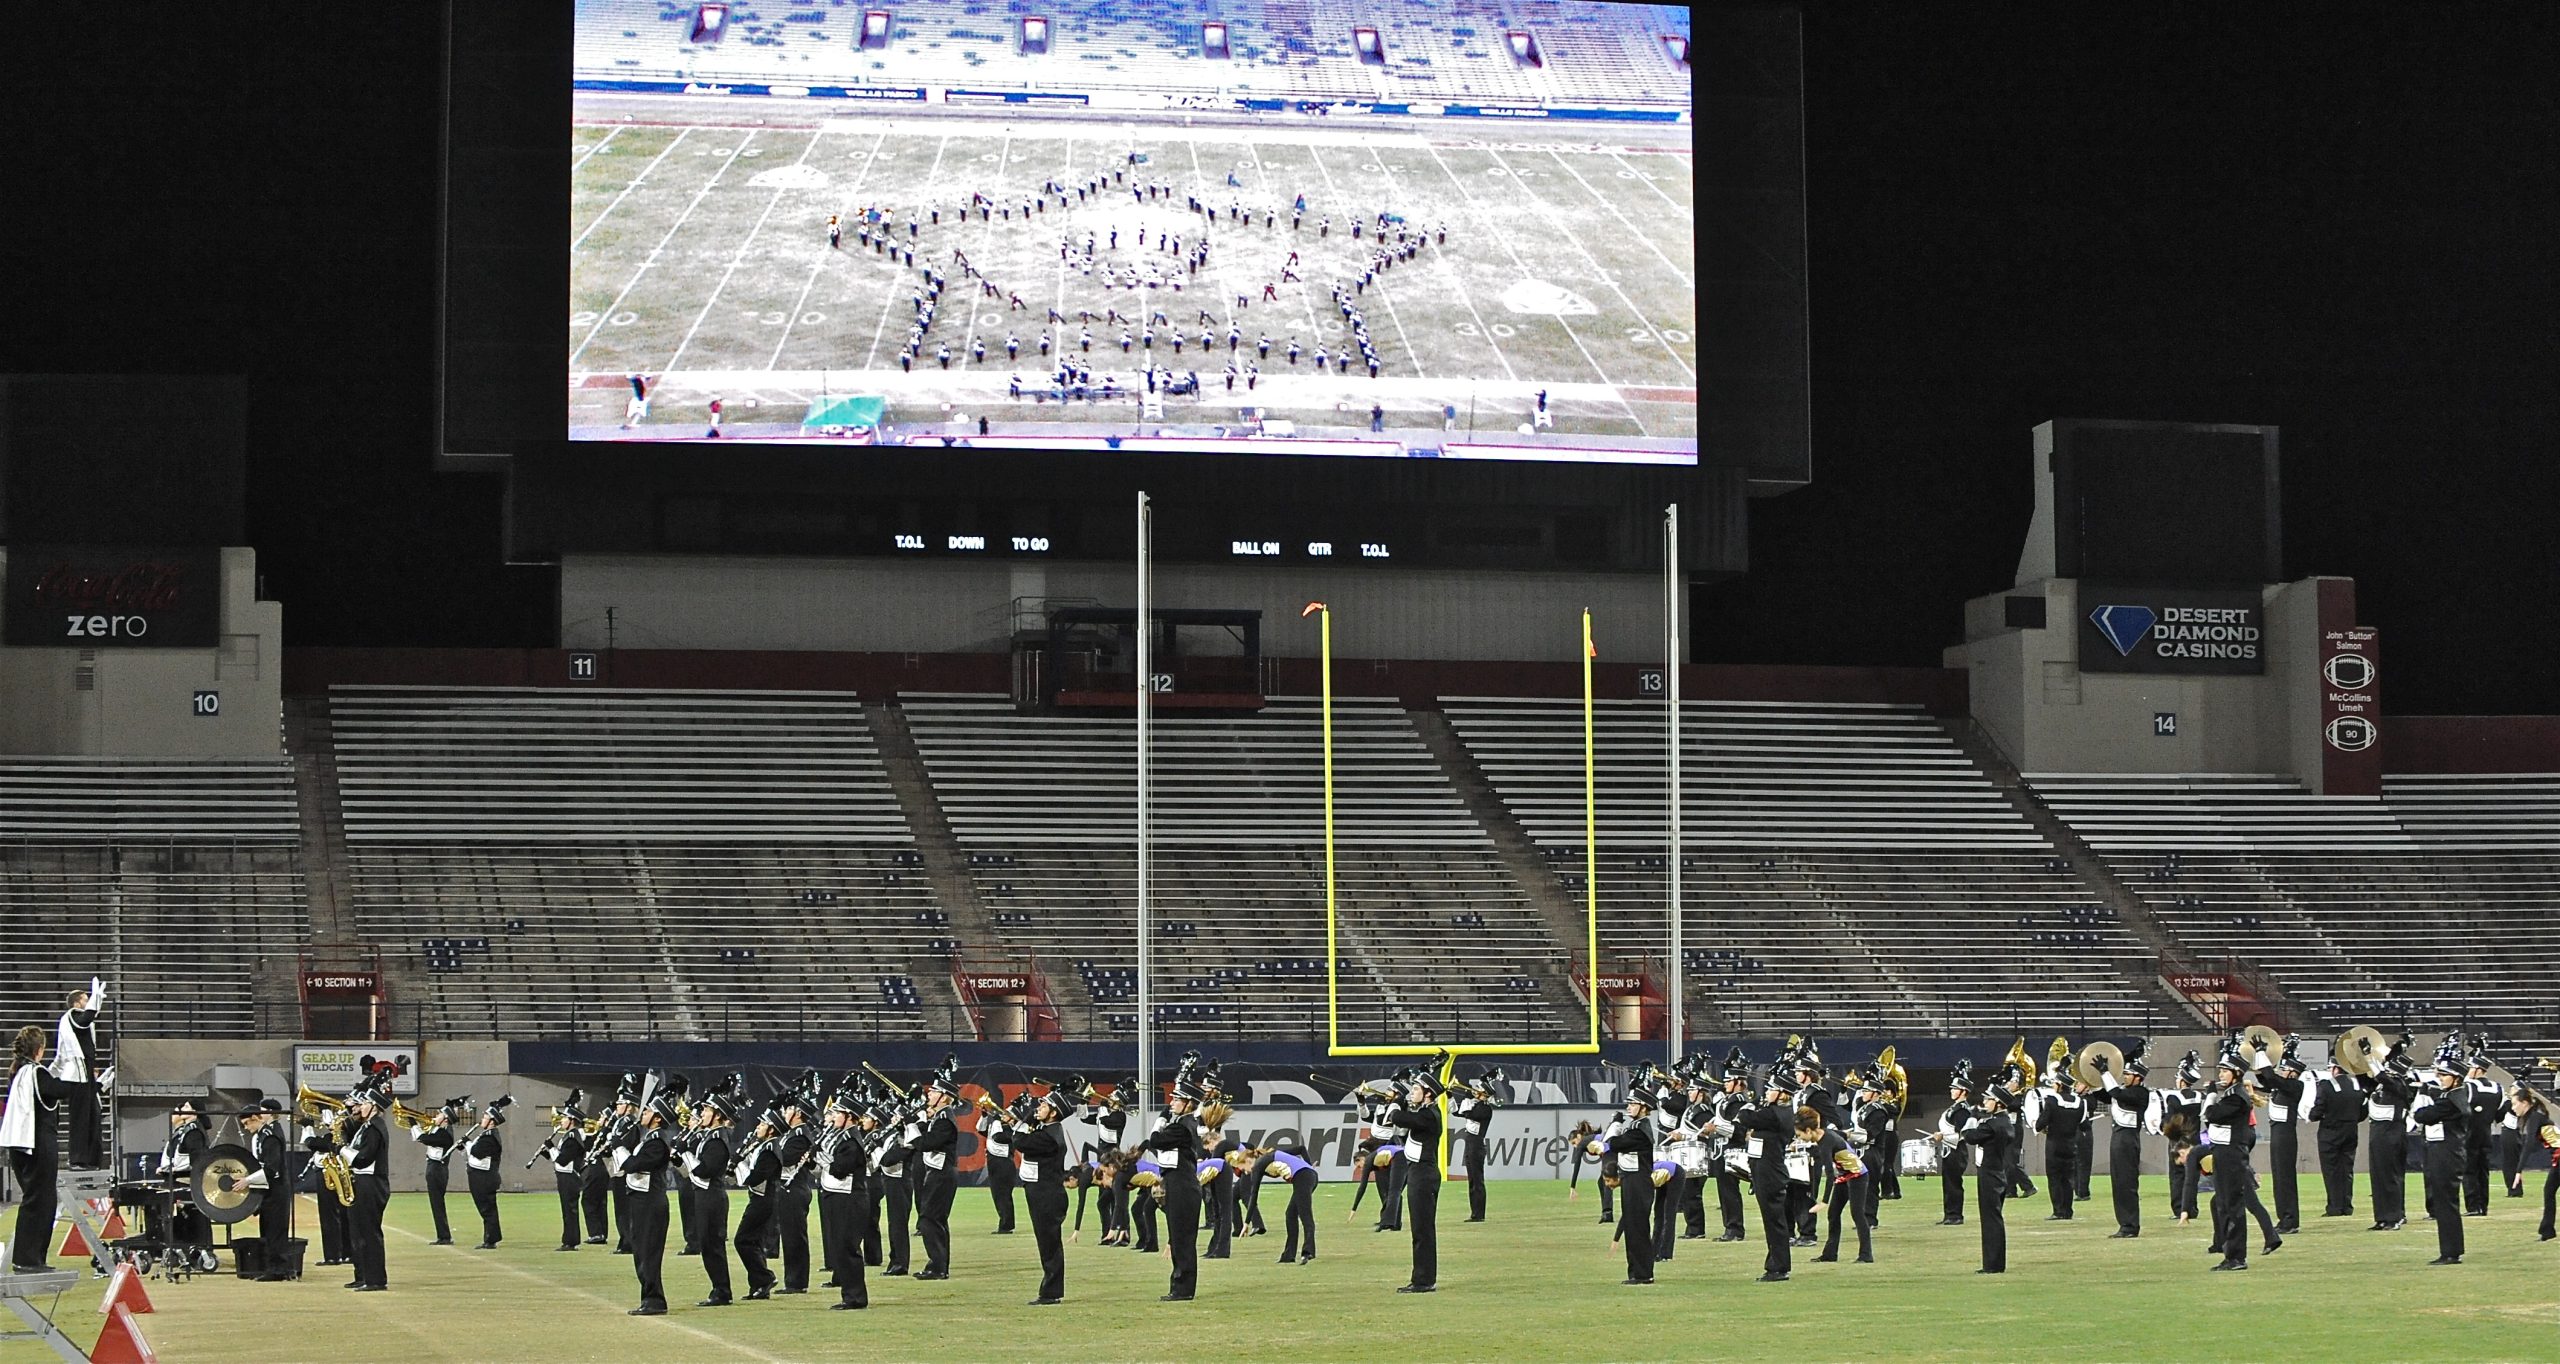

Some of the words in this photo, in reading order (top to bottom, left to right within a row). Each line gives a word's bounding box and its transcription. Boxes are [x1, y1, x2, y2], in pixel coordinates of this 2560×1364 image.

[948, 536, 985, 550] DOWN
[1012, 537, 1029, 550] TO
[1030, 538, 1049, 551] GO
[1232, 541, 1261, 555] BALL
[1262, 542, 1280, 555] ON
[1308, 542, 1332, 556] QTR
[2164, 608, 2249, 623] DESERT
[67, 615, 147, 637] zero
[2154, 625, 2260, 641] DIAMOND
[2326, 631, 2343, 640] John
[2157, 643, 2257, 659] CASINOS
[2336, 641, 2362, 650] Salmon
[574, 658, 592, 675] 11
[1151, 675, 1172, 692] 12
[1640, 673, 1662, 691] 13
[194, 694, 219, 713] 10
[2329, 693, 2372, 702] McCollins
[2338, 703, 2363, 712] Umeh
[2154, 716, 2176, 733] 14
[2345, 730, 2358, 738] 90
[314, 978, 323, 987] 10
[324, 977, 356, 988] SECTION
[358, 978, 365, 987] 11
[977, 978, 1009, 988] SECTION
[1011, 978, 1019, 988] 12
[1626, 978, 1633, 988] 13
[302, 1053, 336, 1064] GEAR
[338, 1054, 355, 1064] UP
[302, 1064, 355, 1072] WILDCATS
[1224, 1111, 1470, 1181] verin
